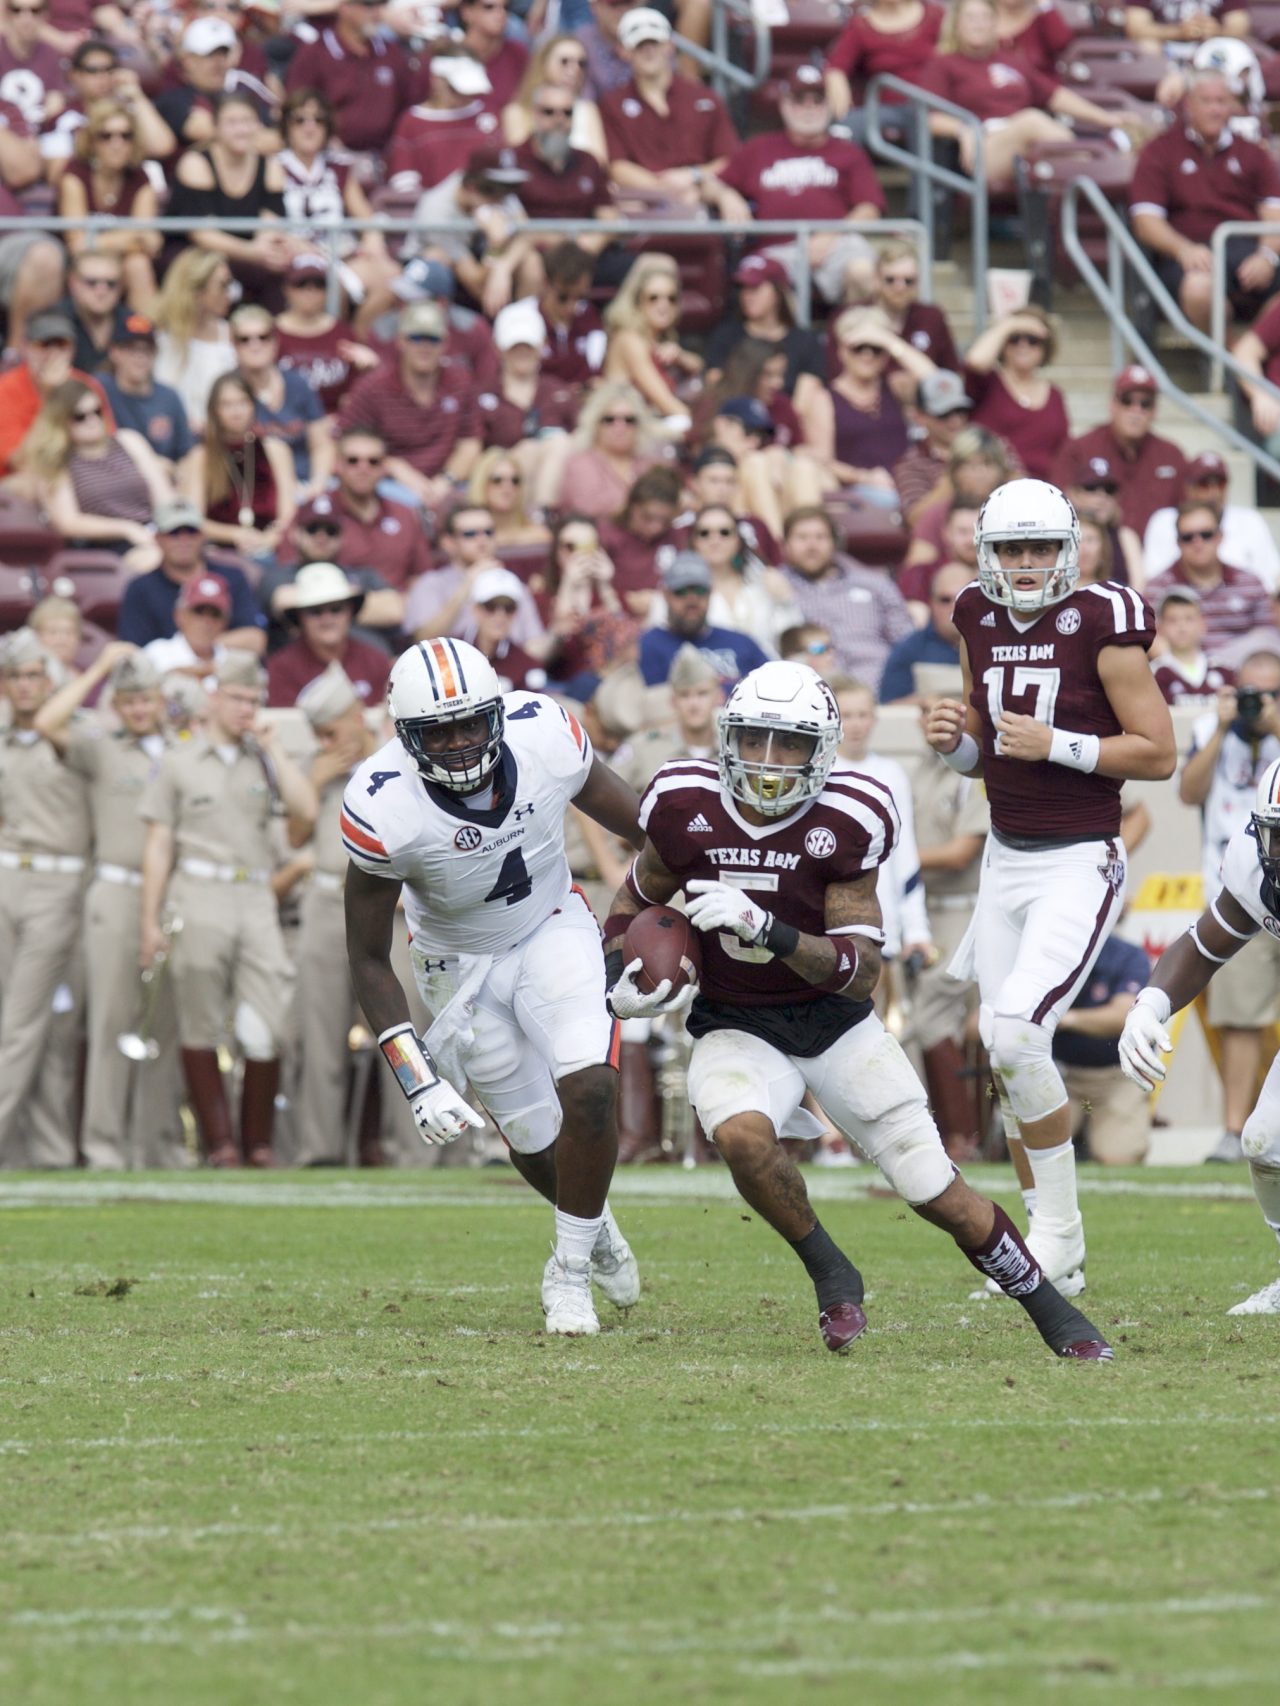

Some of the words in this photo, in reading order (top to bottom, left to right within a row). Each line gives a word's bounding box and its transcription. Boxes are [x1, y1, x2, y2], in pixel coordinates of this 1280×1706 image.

[991, 646, 1026, 662] TEXAS
[1029, 644, 1054, 660] A&M
[442, 699, 463, 709] TIGERS
[506, 701, 542, 720] 4
[983, 666, 1061, 756] 17
[366, 771, 401, 796] 4
[455, 827, 481, 850] SEC
[481, 827, 525, 853] AUBURN
[687, 824, 713, 833] adidas
[806, 828, 836, 857] SEC
[705, 848, 760, 867] TEXAS
[763, 850, 801, 870] A&M
[484, 846, 533, 906] 4
